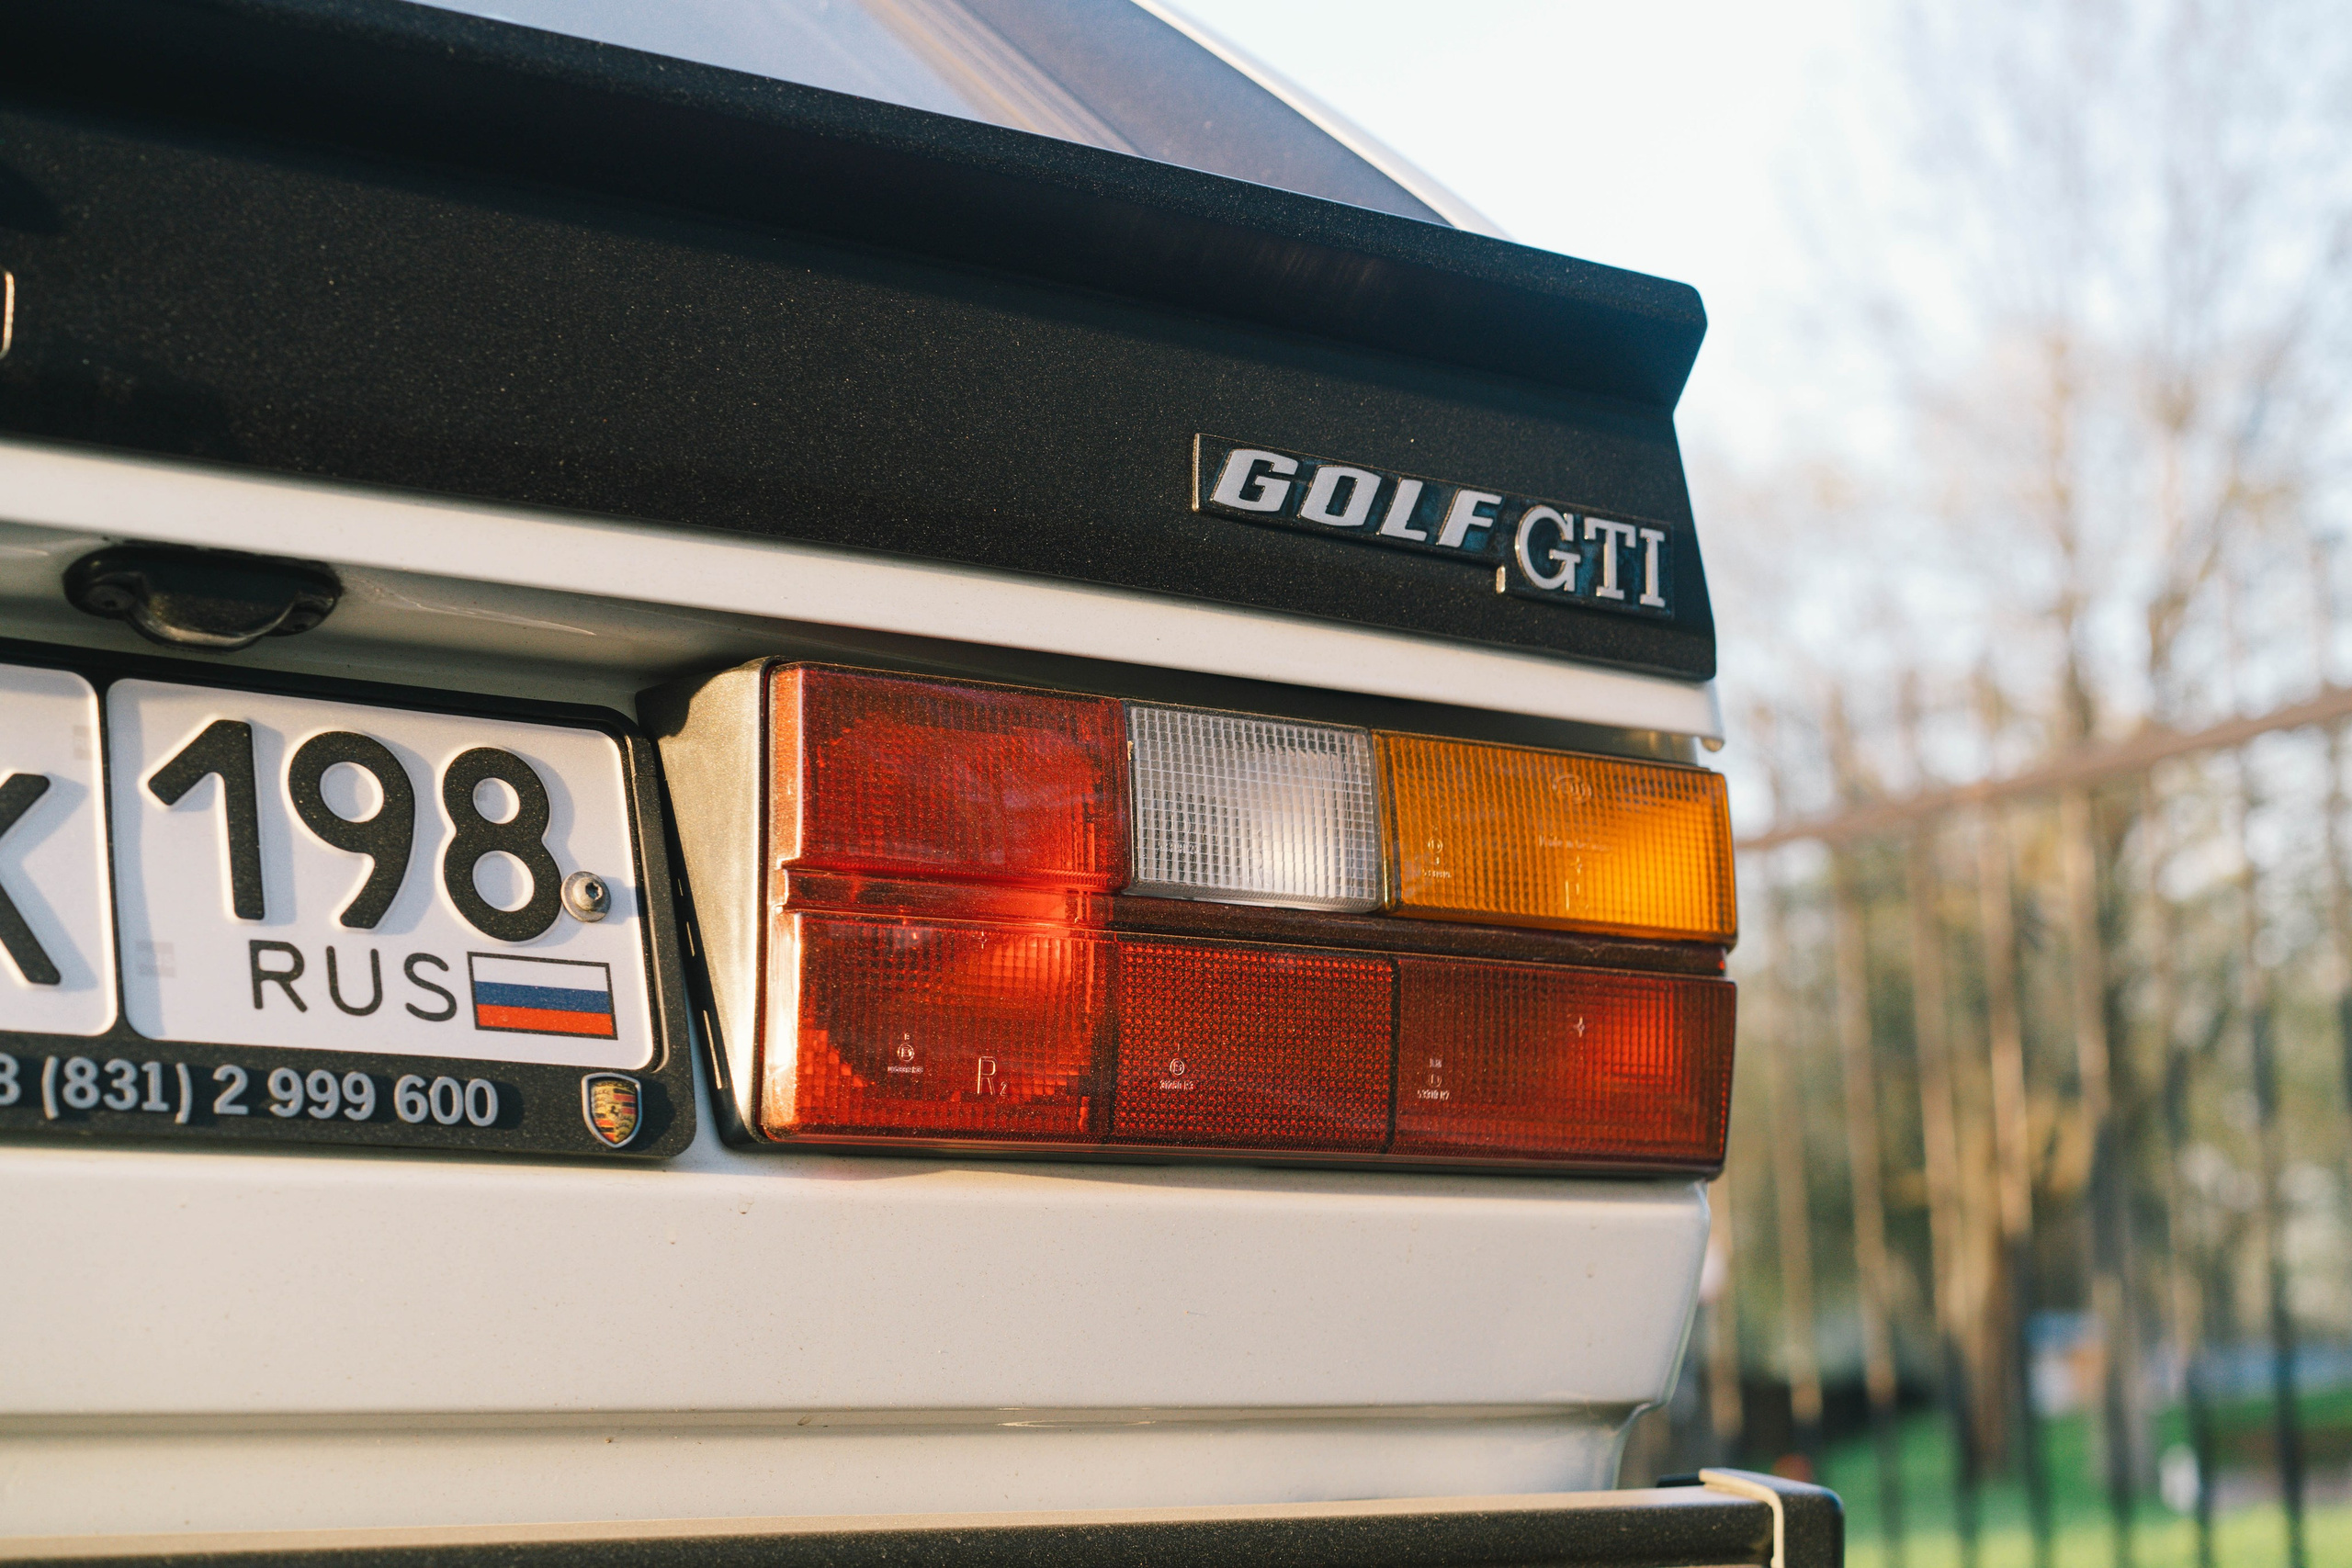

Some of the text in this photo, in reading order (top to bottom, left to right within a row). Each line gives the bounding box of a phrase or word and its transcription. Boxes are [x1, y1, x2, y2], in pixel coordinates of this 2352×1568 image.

[1212, 448, 1667, 608] GOLF GTI
[147, 718, 563, 942] 198
[248, 939, 458, 1022] RUS
[40, 1055, 194, 1124] (831)
[211, 1064, 249, 1116] 2
[266, 1066, 377, 1122] 999
[392, 1073, 499, 1127] 600
